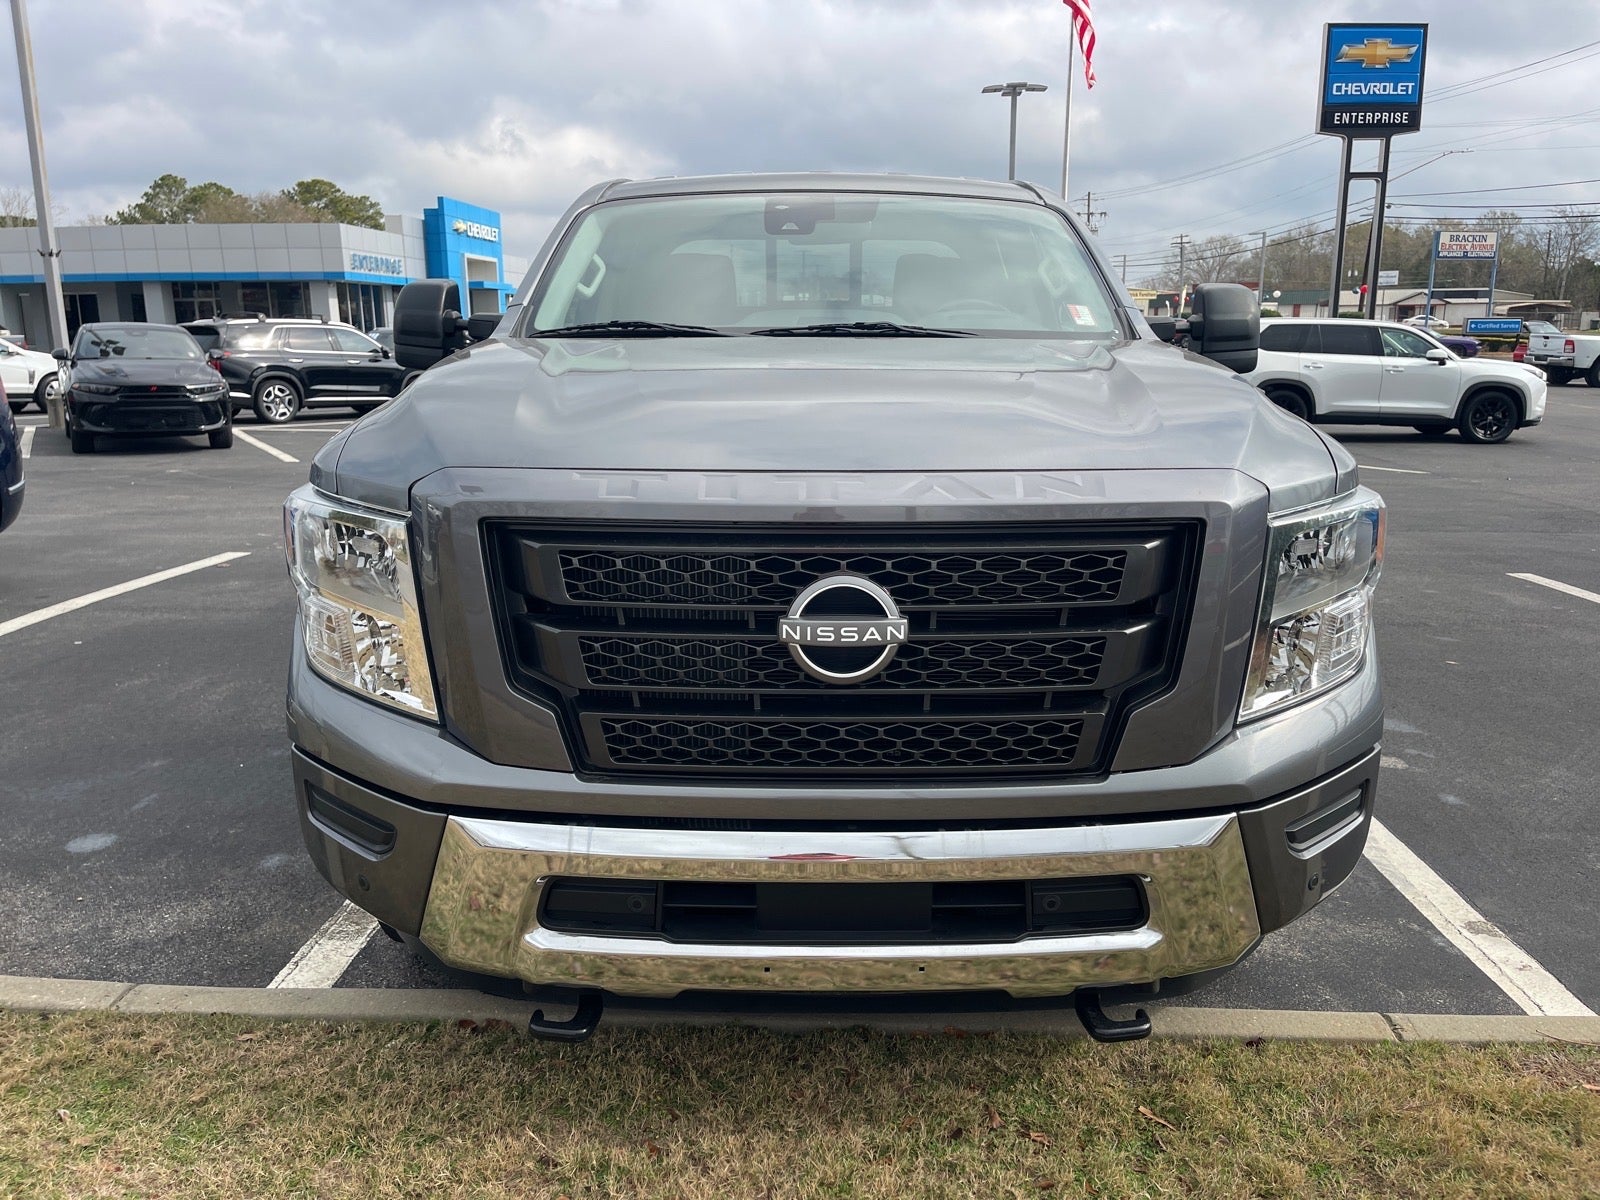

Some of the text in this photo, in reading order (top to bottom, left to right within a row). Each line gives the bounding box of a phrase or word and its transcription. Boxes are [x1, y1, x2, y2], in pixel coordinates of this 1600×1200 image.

[1332, 82, 1415, 95] CHEVROLET
[1334, 112, 1409, 125] ENTERPRISE
[466, 221, 499, 242] CHEVROLET
[1449, 234, 1488, 243] BRACKIN
[1440, 242, 1495, 251] ELECTRIC AVENUE
[351, 252, 403, 275] ENTERPRISE
[571, 472, 1106, 500] TITAN
[782, 624, 905, 642] NISSAN
